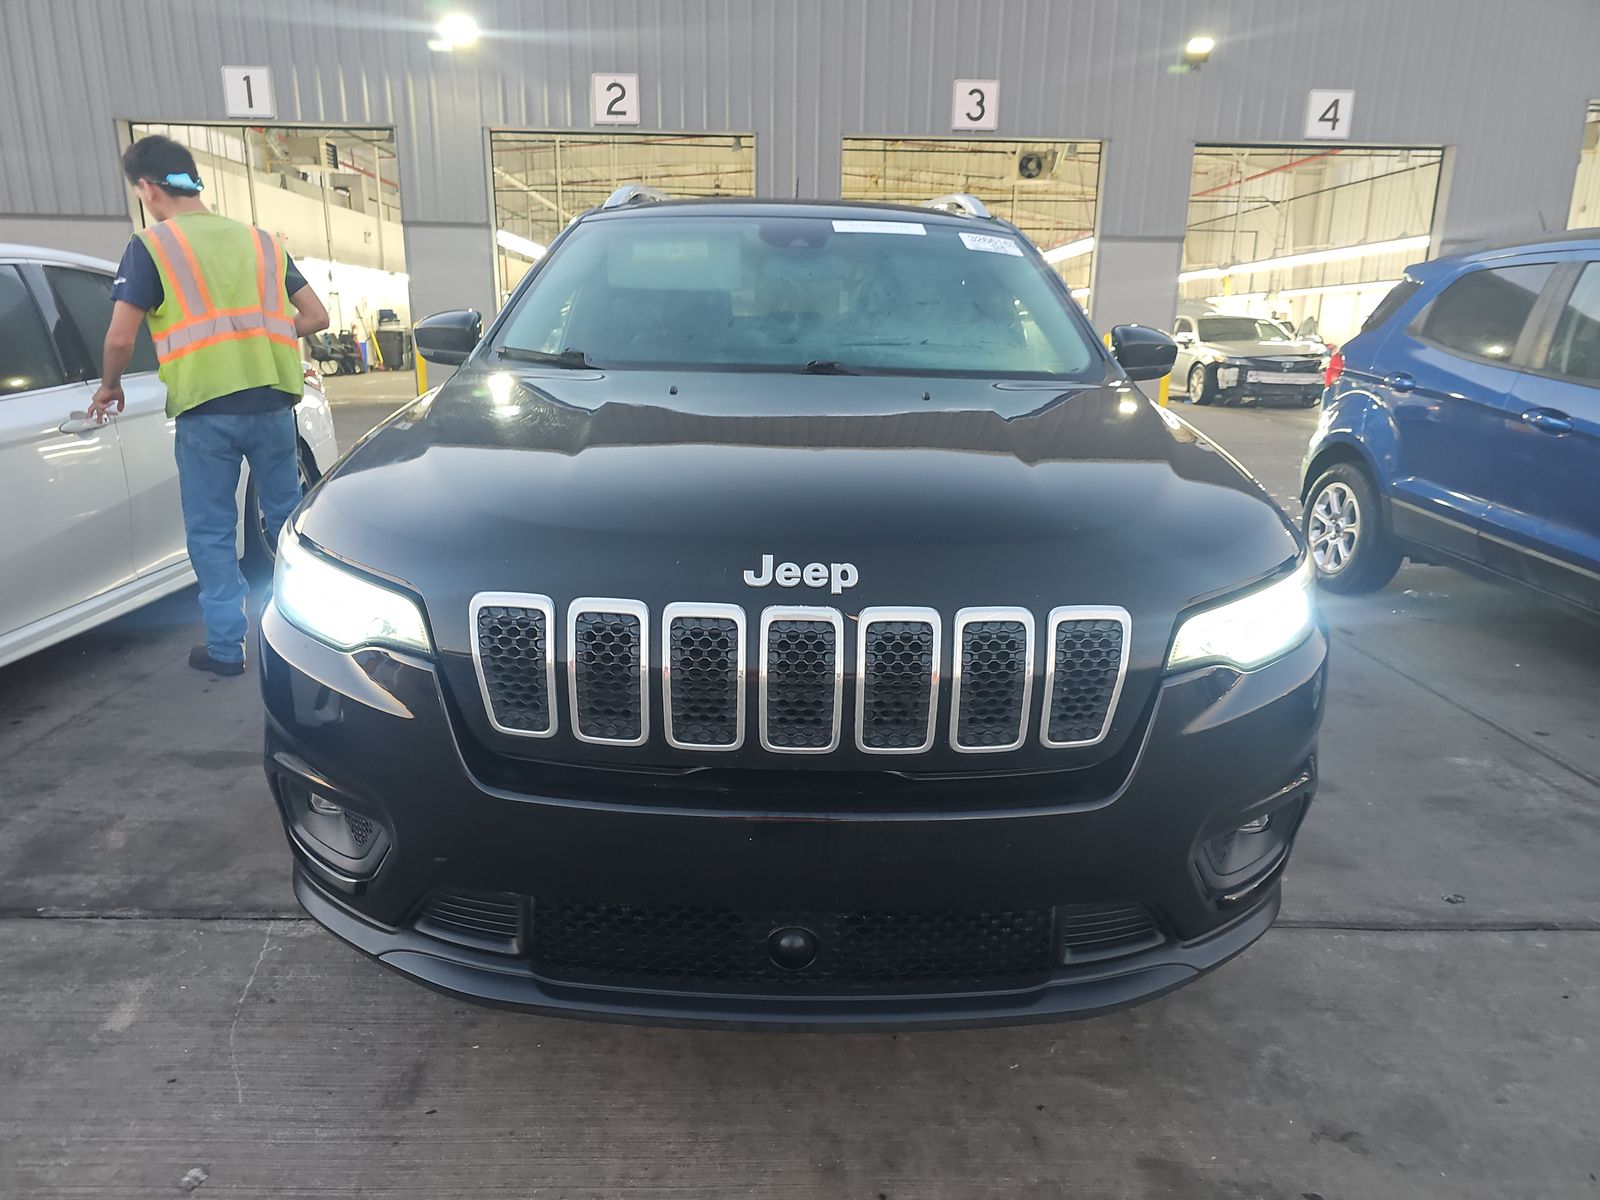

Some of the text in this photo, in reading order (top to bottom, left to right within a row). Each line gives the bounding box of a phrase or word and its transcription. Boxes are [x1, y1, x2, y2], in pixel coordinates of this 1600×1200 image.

[242, 75, 254, 109] 1
[605, 82, 627, 117] 2
[966, 88, 985, 123] 3
[1318, 98, 1341, 132] 4
[742, 553, 859, 595] Jeep
